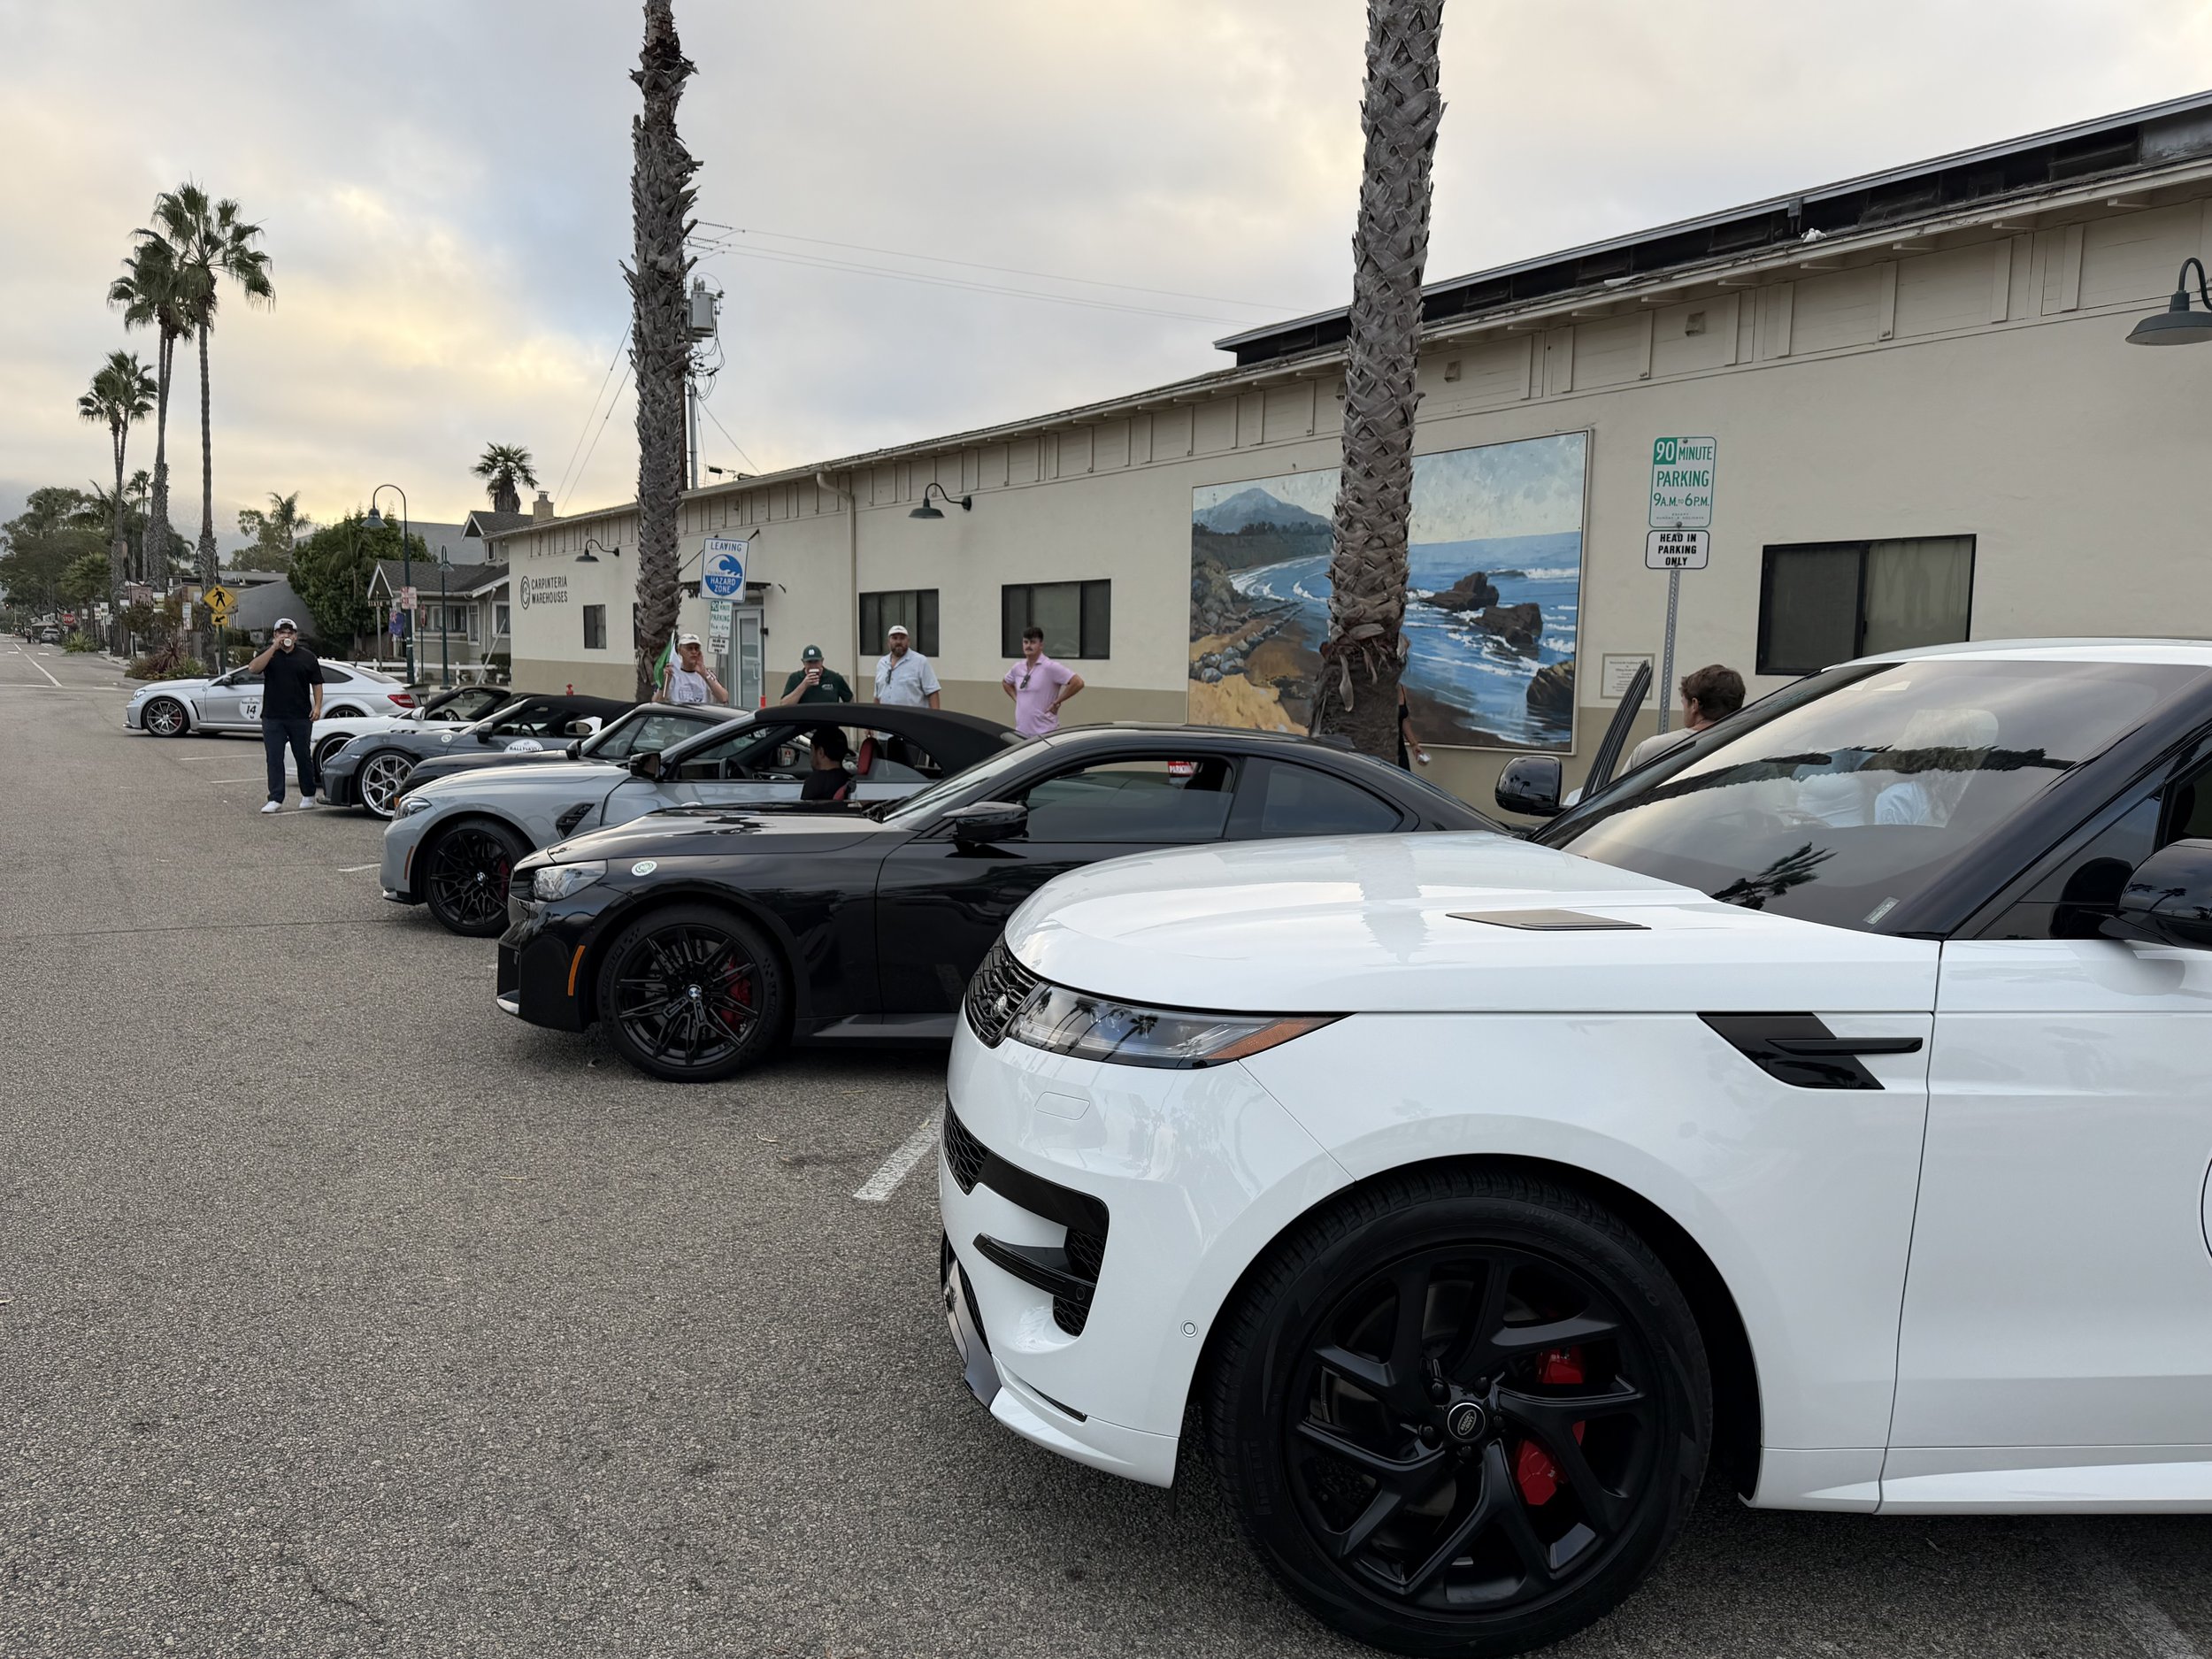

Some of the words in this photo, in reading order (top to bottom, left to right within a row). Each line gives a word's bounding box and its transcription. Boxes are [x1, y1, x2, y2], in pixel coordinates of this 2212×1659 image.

[1655, 441, 1675, 462] 90
[1678, 445, 1713, 461] MINUTE
[1656, 470, 1709, 488] PARKING
[1660, 533, 1683, 543] HEAD
[1686, 534, 1696, 542] IN
[710, 541, 742, 552] LEAVING
[1657, 545, 1697, 555] PARKING
[1665, 557, 1688, 566] ONLY
[531, 575, 568, 590] CARPINTERIA
[710, 577, 736, 586] HAZARD
[714, 584, 731, 593] ZONE
[532, 591, 568, 604] WAREHOUSES
[246, 705, 257, 714] 14
